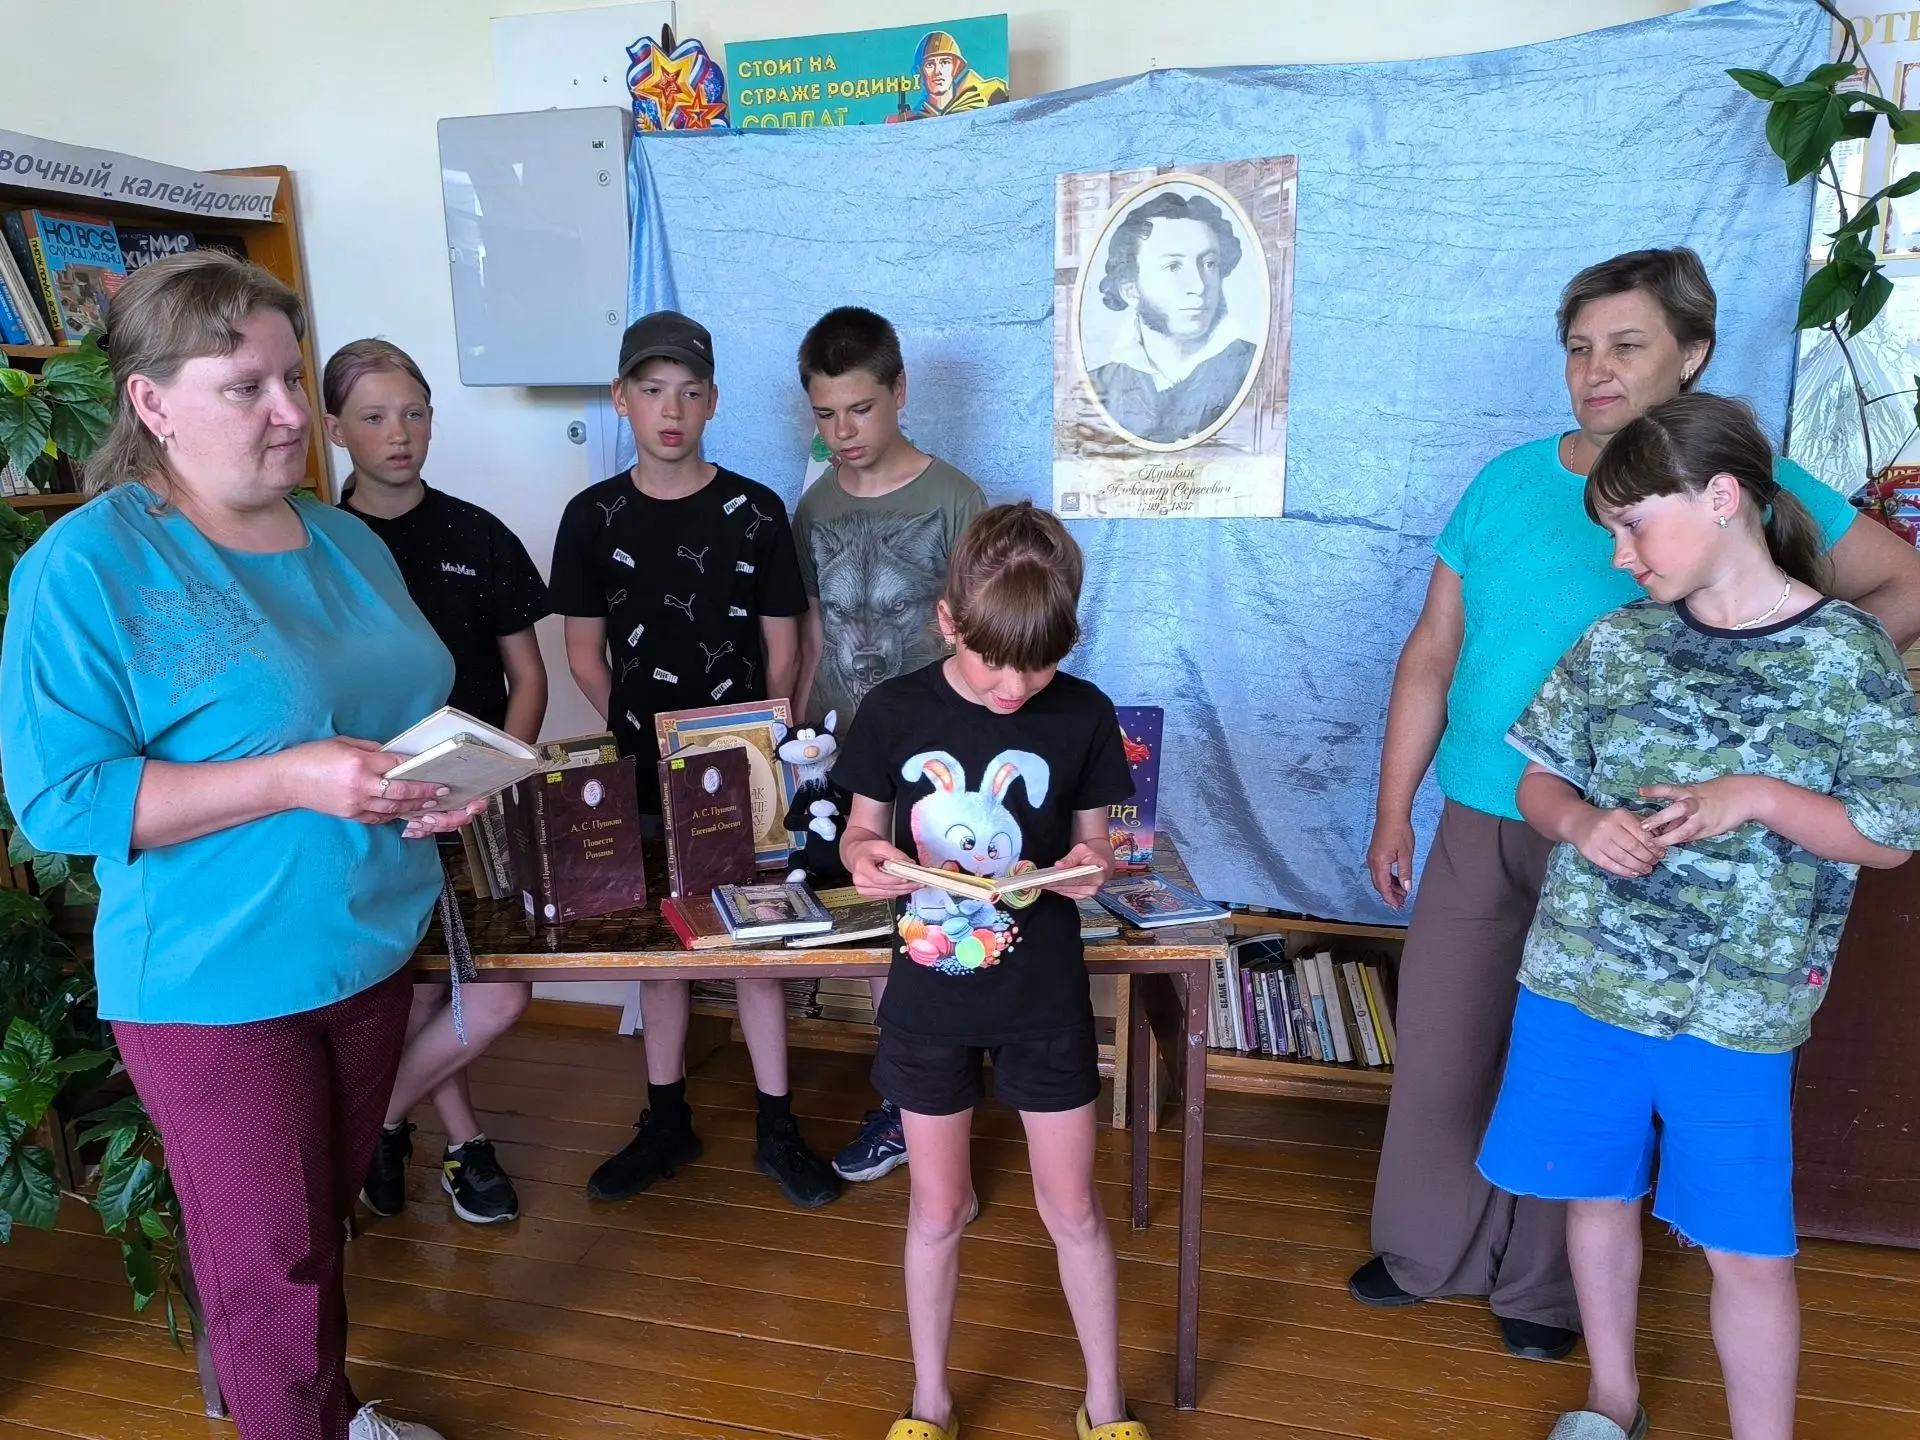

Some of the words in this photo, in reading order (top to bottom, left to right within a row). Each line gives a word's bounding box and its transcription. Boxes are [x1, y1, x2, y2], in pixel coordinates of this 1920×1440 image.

[738, 57, 803, 78] СТОИТ
[809, 54, 838, 73] НА
[740, 84, 821, 106] СТРАЖЕ
[827, 74, 921, 98] РОДИНЫ
[119, 175, 273, 213] калейдоскоп
[150, 234, 189, 252] МИР
[1138, 462, 1195, 483] Пушкин
[711, 804, 737, 816] Пушкин
[592, 819, 622, 830] Пушкин
[691, 824, 716, 837] Евгений
[718, 820, 741, 833] Онегин
[583, 837, 614, 848] Повести
[586, 850, 614, 860] Романы
